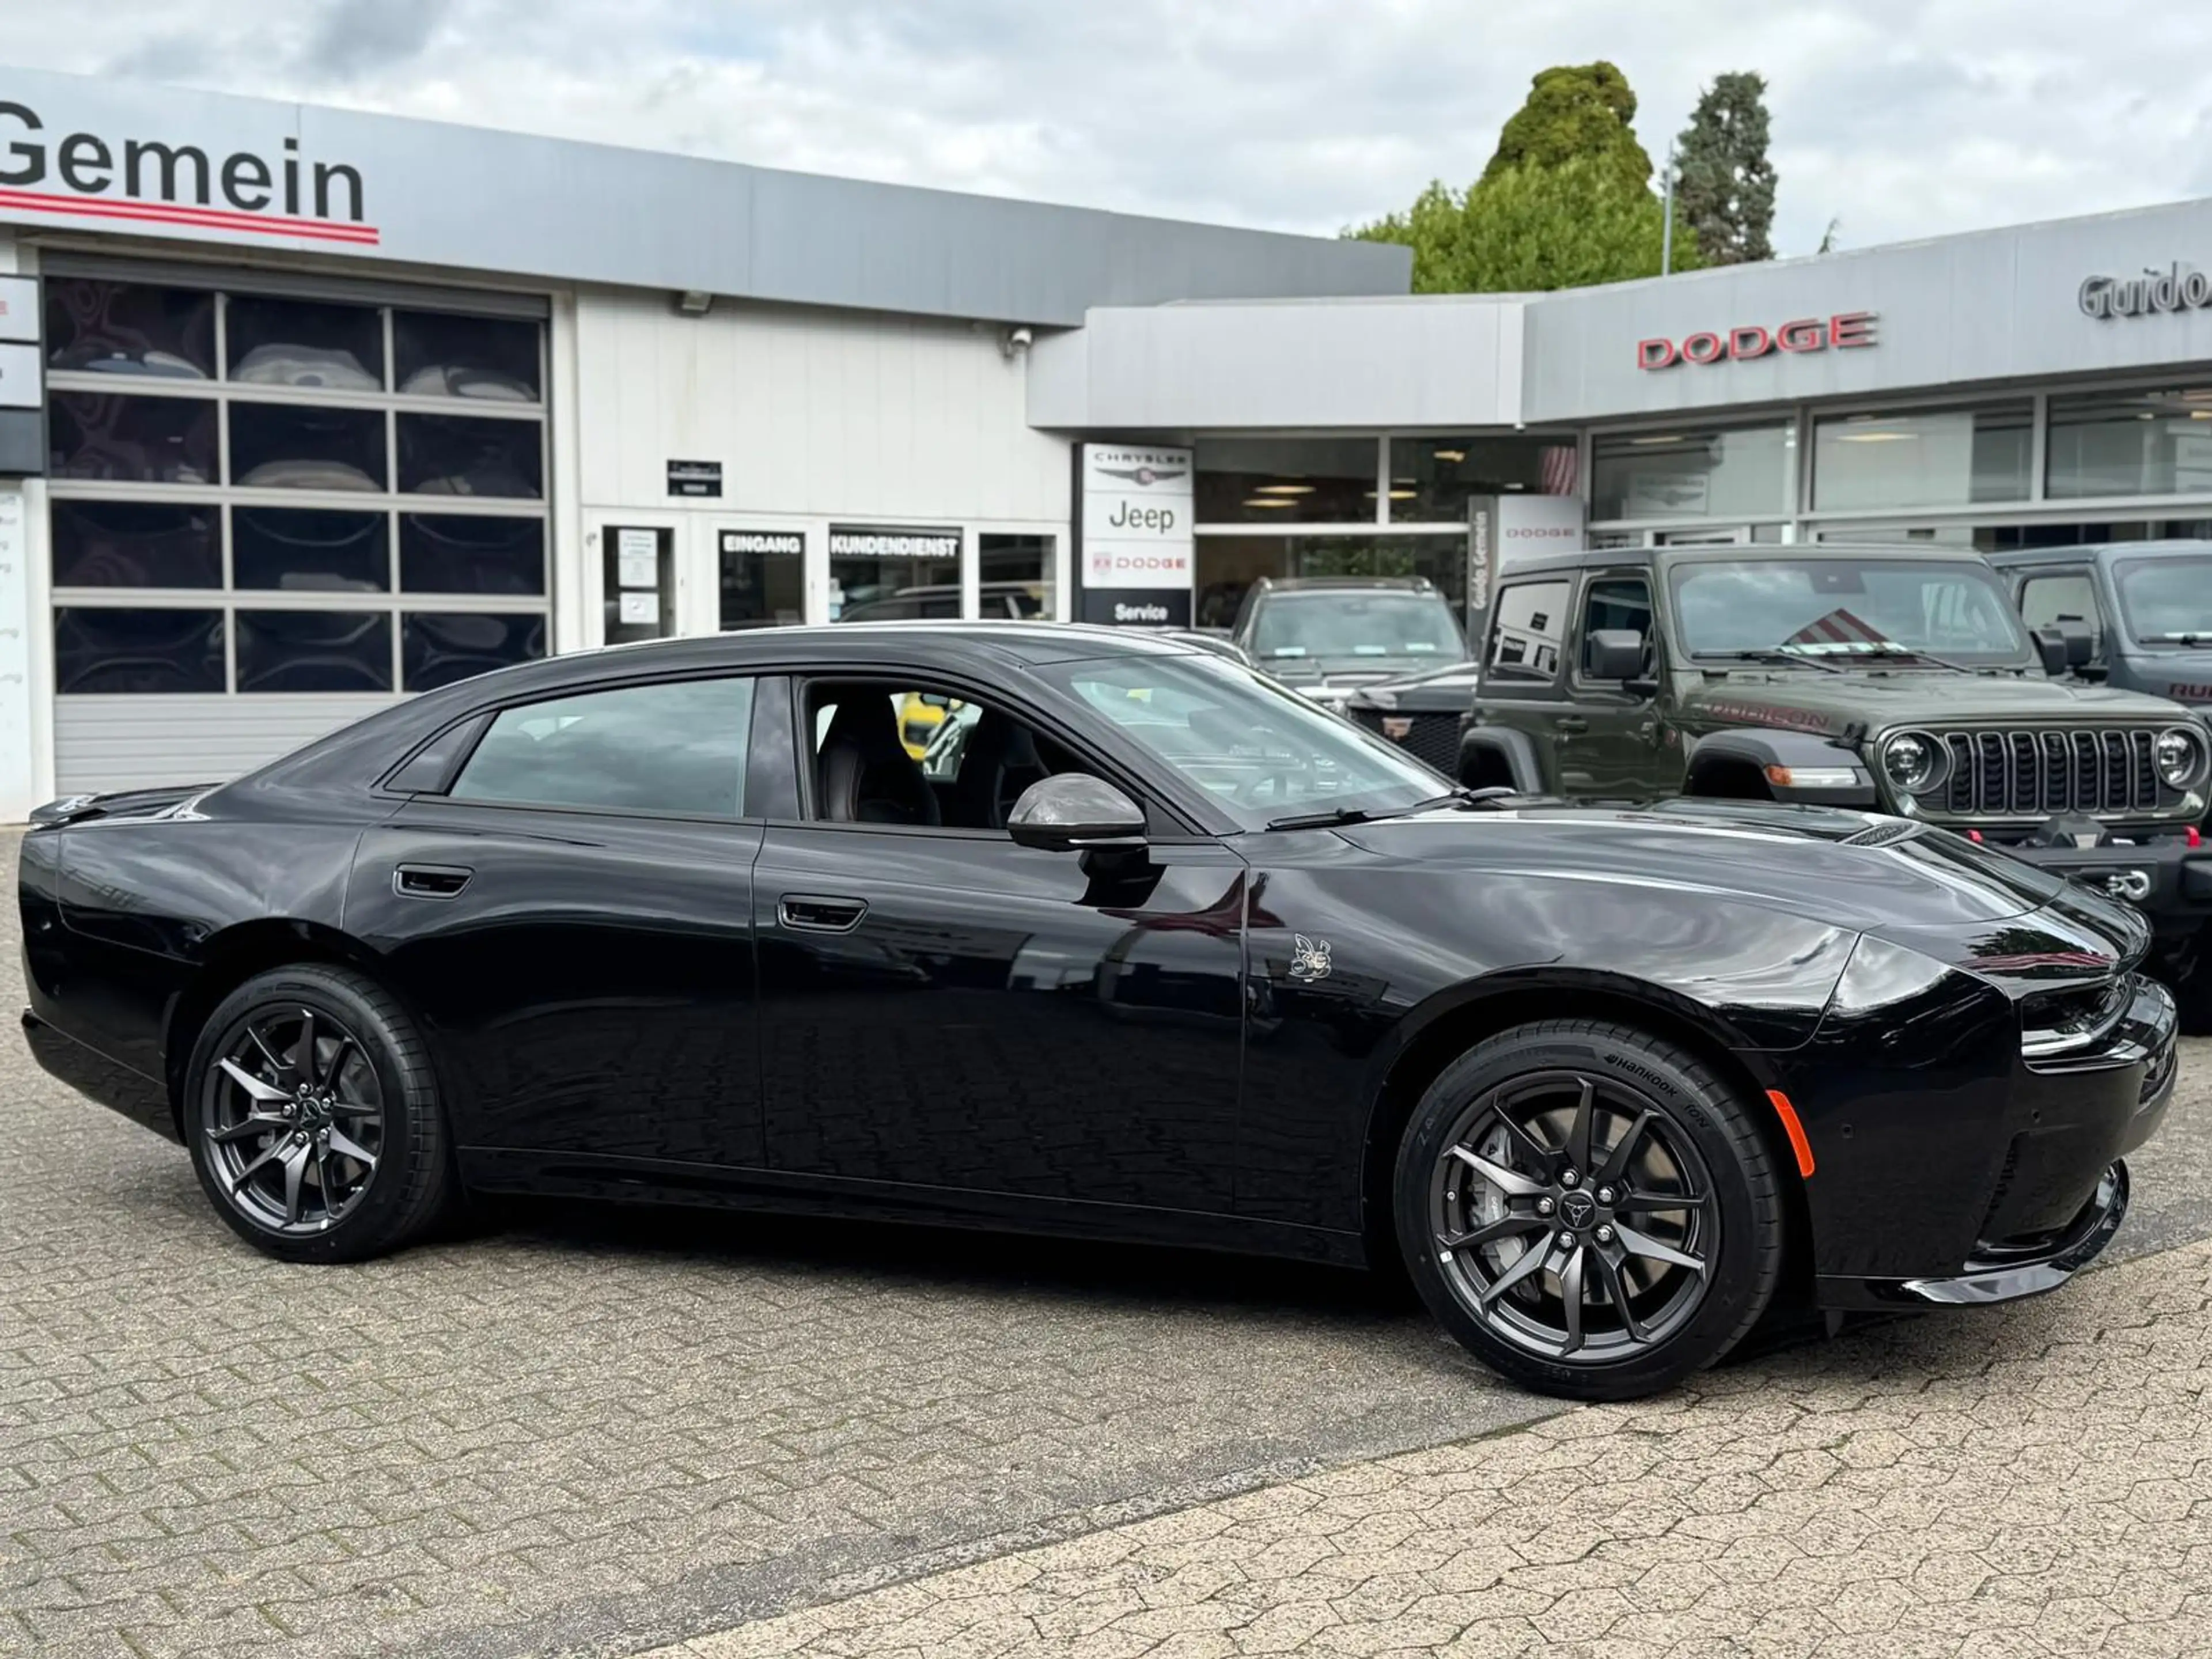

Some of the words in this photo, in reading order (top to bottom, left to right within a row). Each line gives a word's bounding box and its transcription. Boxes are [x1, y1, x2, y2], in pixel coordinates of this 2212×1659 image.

[0, 100, 364, 221] Gemein
[2078, 261, 2208, 318] Guido
[1637, 312, 1878, 369] DODGE
[1094, 452, 1186, 464] CHRYSLER
[1109, 500, 1174, 535] Jeep
[1506, 528, 1575, 538] DODGE
[724, 535, 801, 554] EINGANG
[830, 535, 957, 556] KUNDENDIENST
[1116, 557, 1186, 569] DODGE
[1115, 603, 1169, 621] Service
